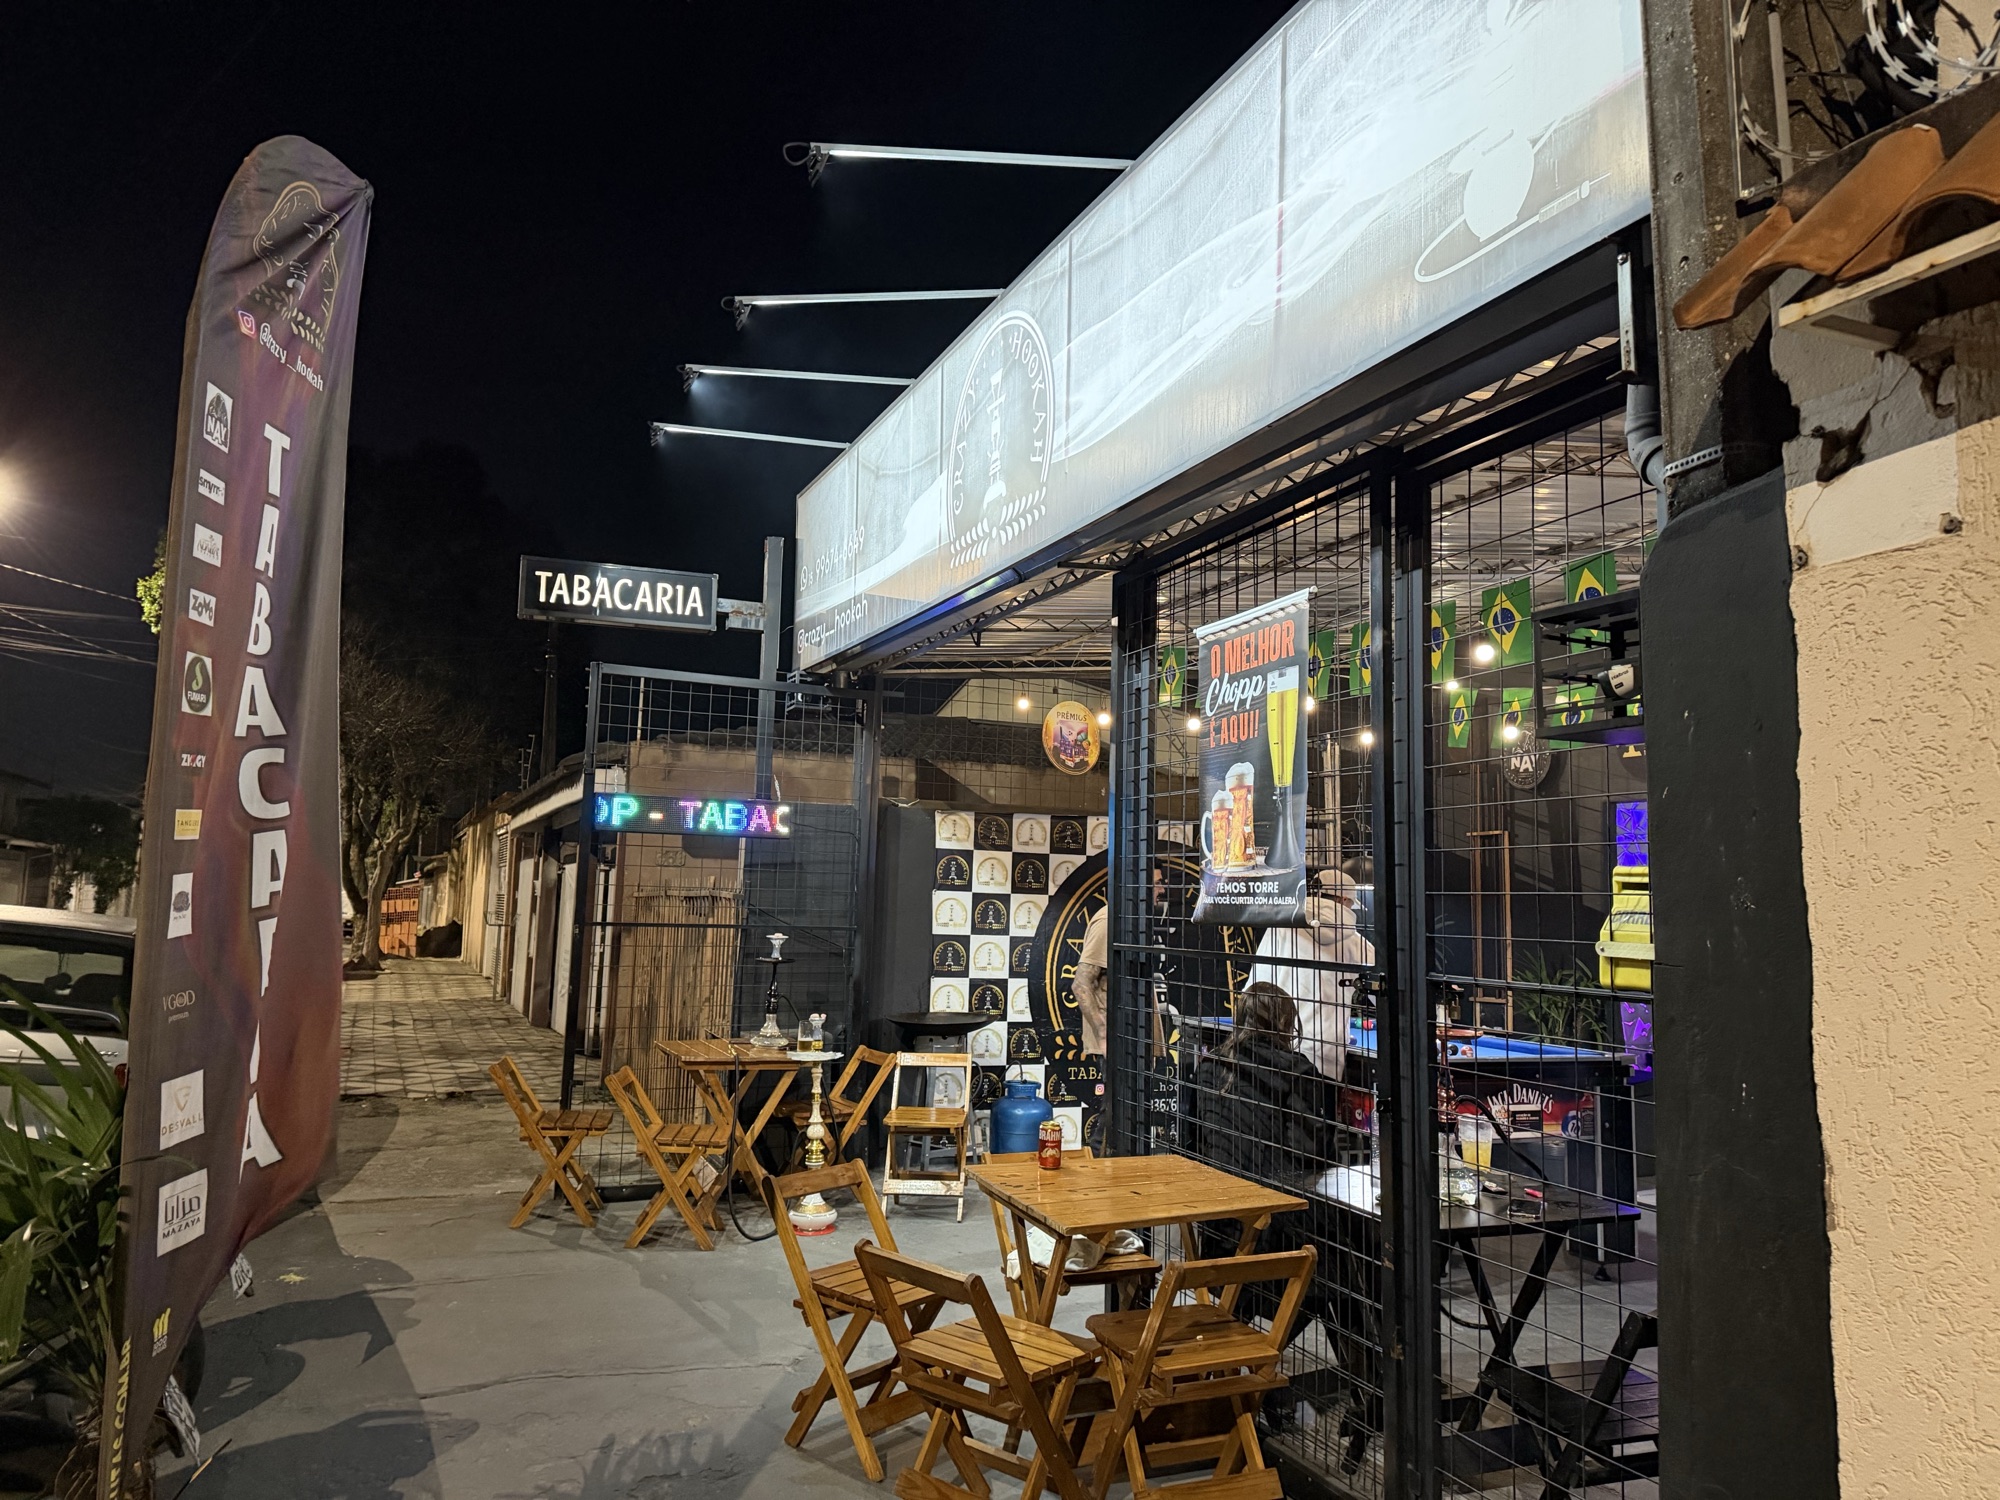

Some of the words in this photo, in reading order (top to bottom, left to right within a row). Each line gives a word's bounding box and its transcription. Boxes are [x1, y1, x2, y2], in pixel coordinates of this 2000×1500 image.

[953, 381, 976, 516] CRAZY
[1010, 326, 1047, 464] HOOKAH
[534, 570, 705, 617] TABACARIA
[1210, 644, 1221, 680] O
[1224, 619, 1296, 675] MELHOR
[1205, 672, 1265, 717] Chopp
[1056, 710, 1088, 722] PRÊMIOS
[1209, 716, 1216, 749] É
[1220, 708, 1260, 746] AQUI!
[233, 422, 291, 1184] TABACAA
[1214, 894, 1231, 905] VOCÊ
[1230, 896, 1254, 905] CURTIR
[1254, 896, 1268, 905] COM
[1268, 896, 1274, 905] A
[1273, 896, 1297, 905] GALERA
[1216, 881, 1247, 894] TEMOS
[1248, 881, 1279, 894] TORRE
[162, 989, 196, 1012] VGOD
[161, 1111, 204, 1137] DESVALL
[162, 1216, 201, 1240] MAZAYA
